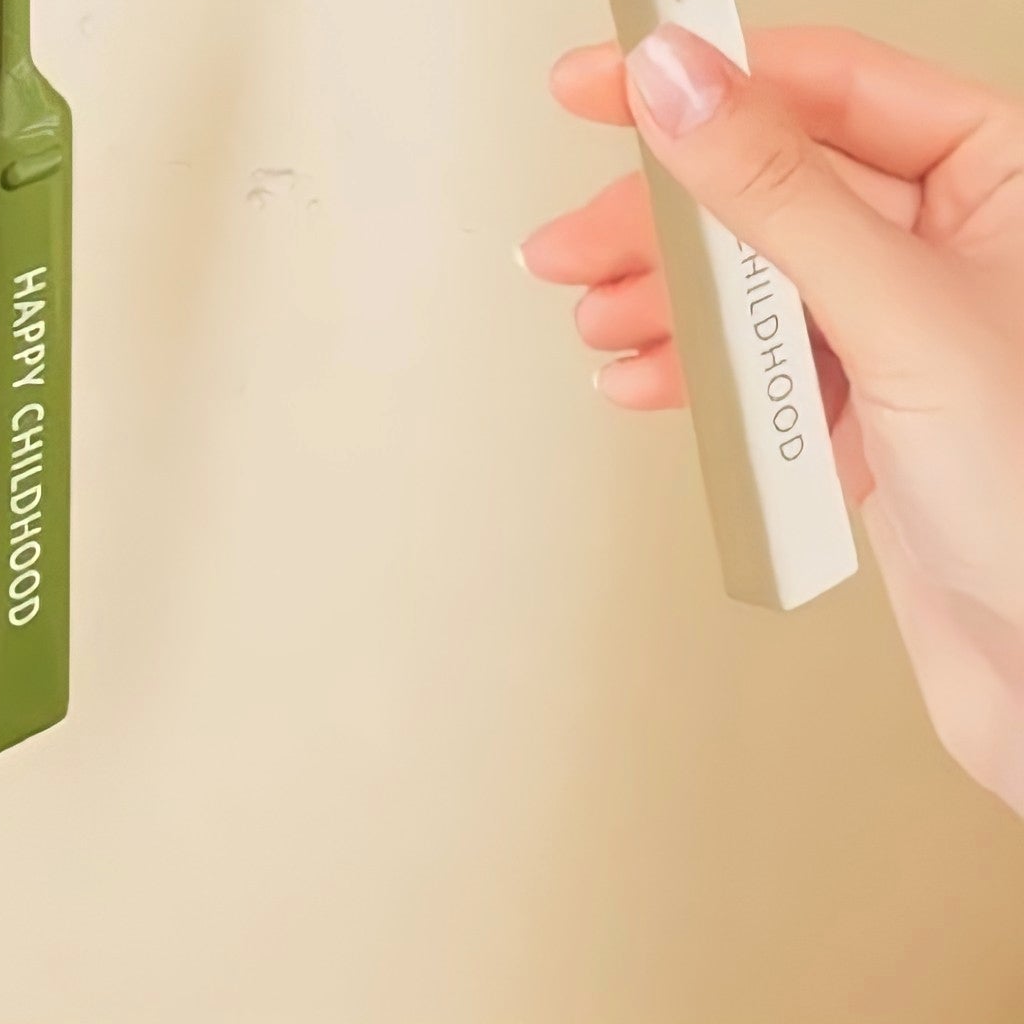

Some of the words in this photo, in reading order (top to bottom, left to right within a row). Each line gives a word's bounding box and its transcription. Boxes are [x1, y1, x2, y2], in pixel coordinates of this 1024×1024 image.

[12, 266, 47, 388] HAPPY
[737, 239, 804, 462] HILDHOOD
[8, 402, 45, 626] CHILDHOOD
